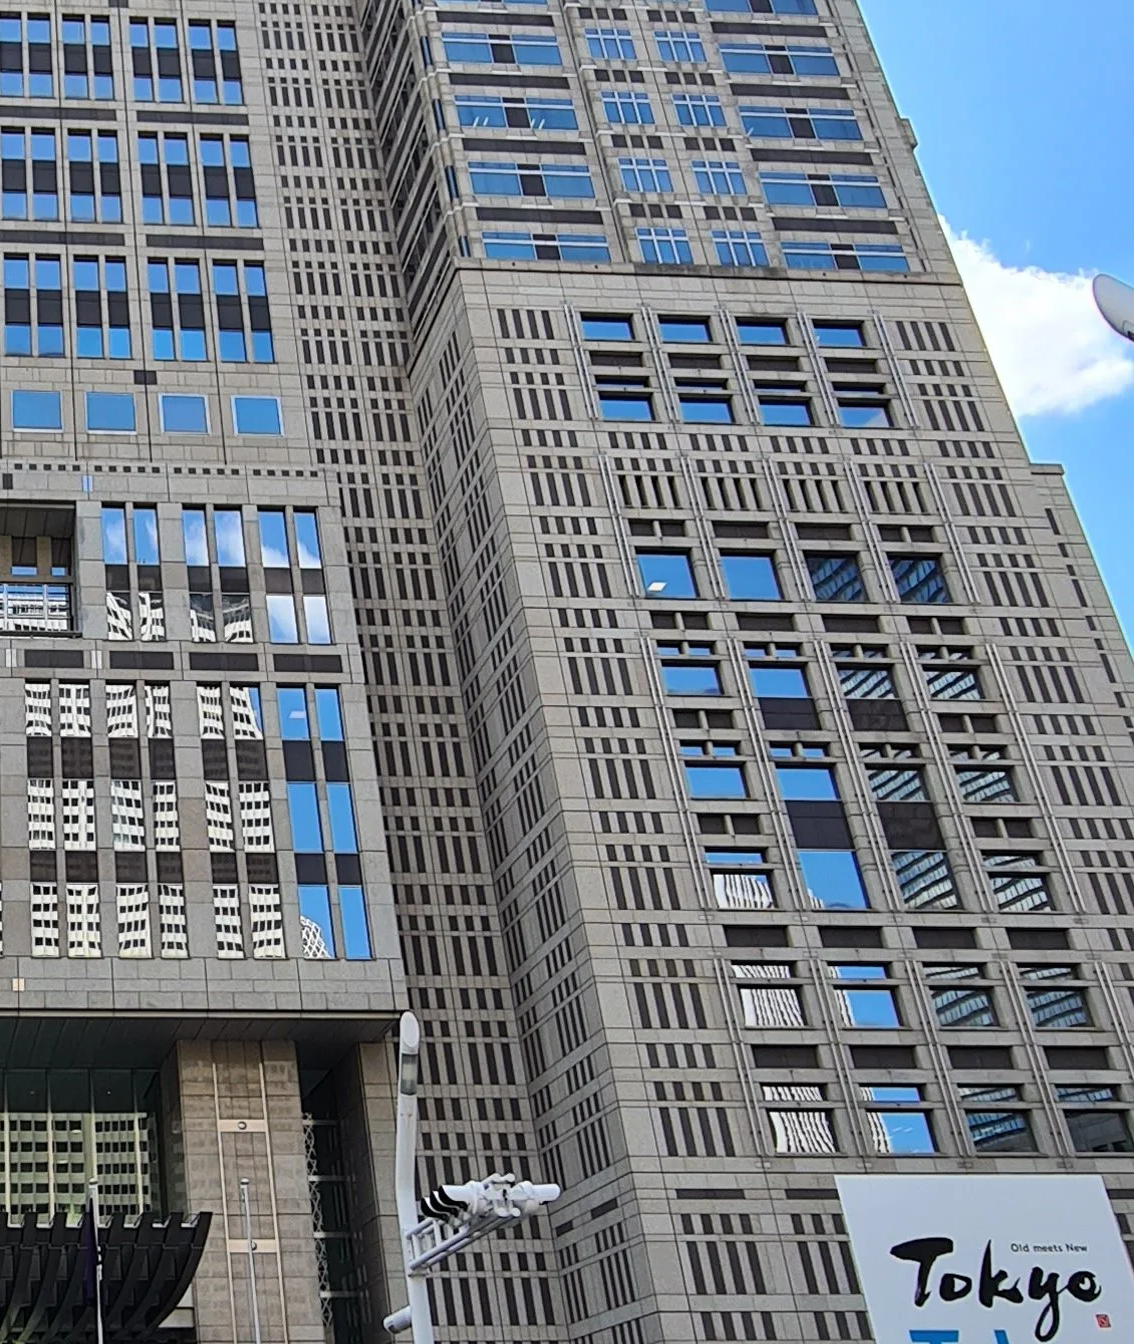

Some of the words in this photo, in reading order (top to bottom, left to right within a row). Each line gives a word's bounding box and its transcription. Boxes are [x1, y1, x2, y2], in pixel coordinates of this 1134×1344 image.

[1011, 1243, 1030, 1253] Old
[1033, 1244, 1063, 1253] meets
[1066, 1243, 1088, 1253] New
[890, 1236, 1102, 1343] Tokyo
